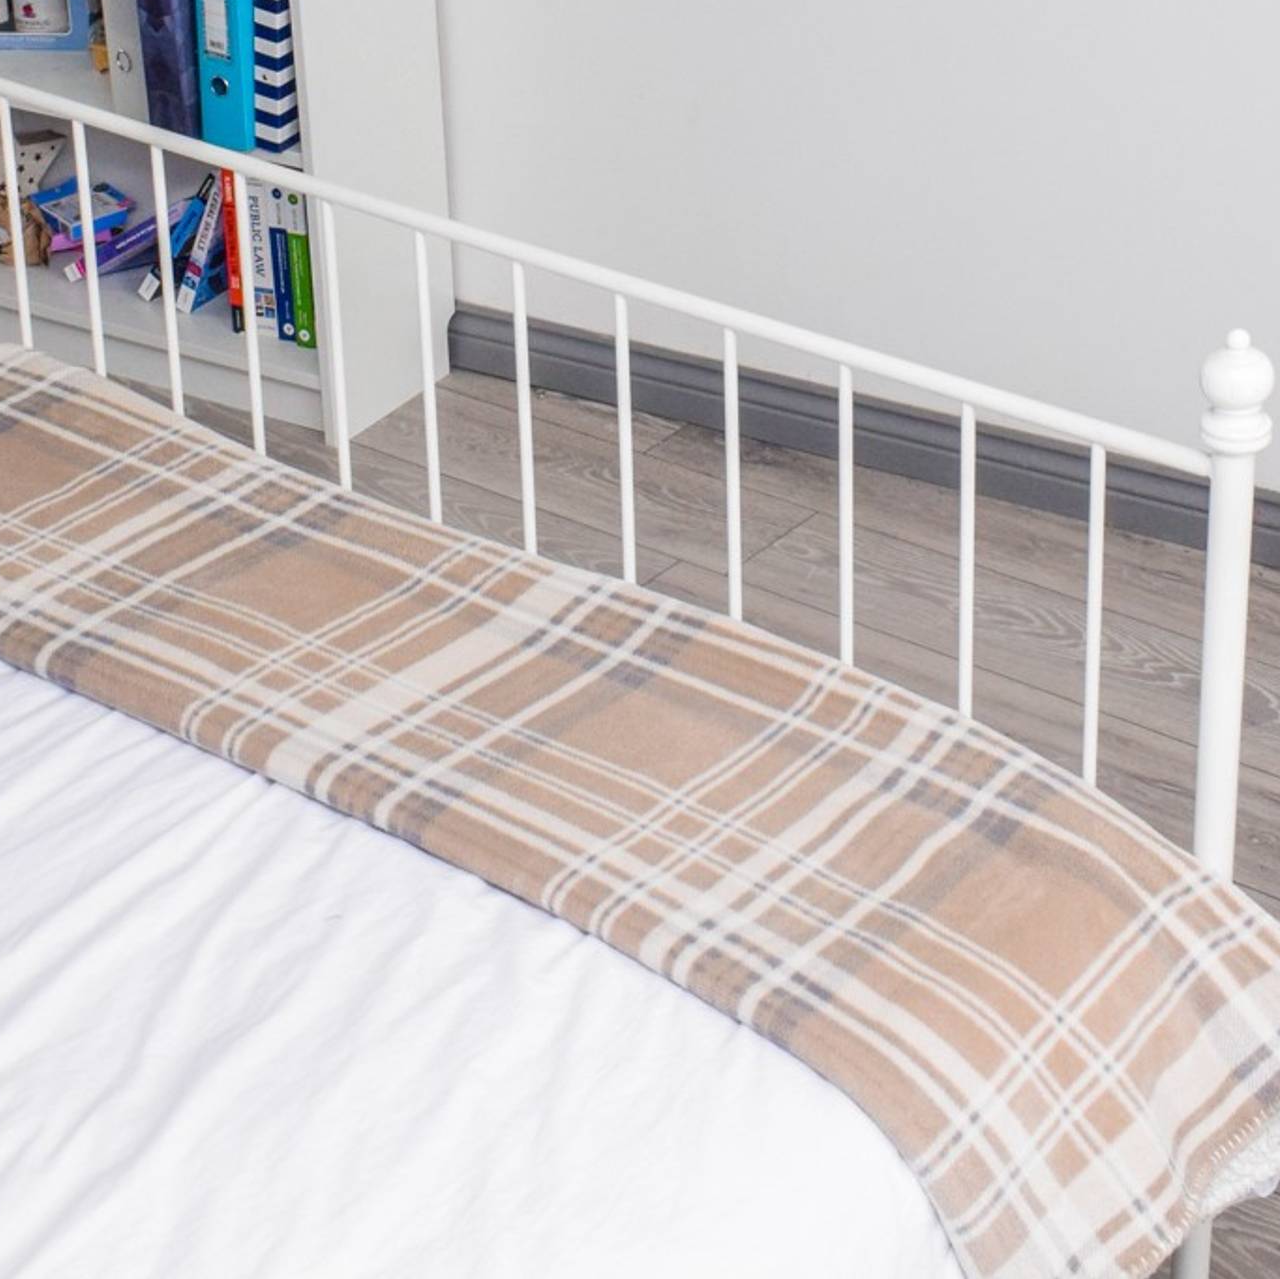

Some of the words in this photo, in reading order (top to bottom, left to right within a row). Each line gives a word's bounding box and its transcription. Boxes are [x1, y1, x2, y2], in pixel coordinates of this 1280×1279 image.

[206, 191, 220, 218] LEGAL
[249, 194, 262, 243] PUBLIC
[197, 220, 212, 250] SKILLS
[253, 244, 265, 279] LAW
